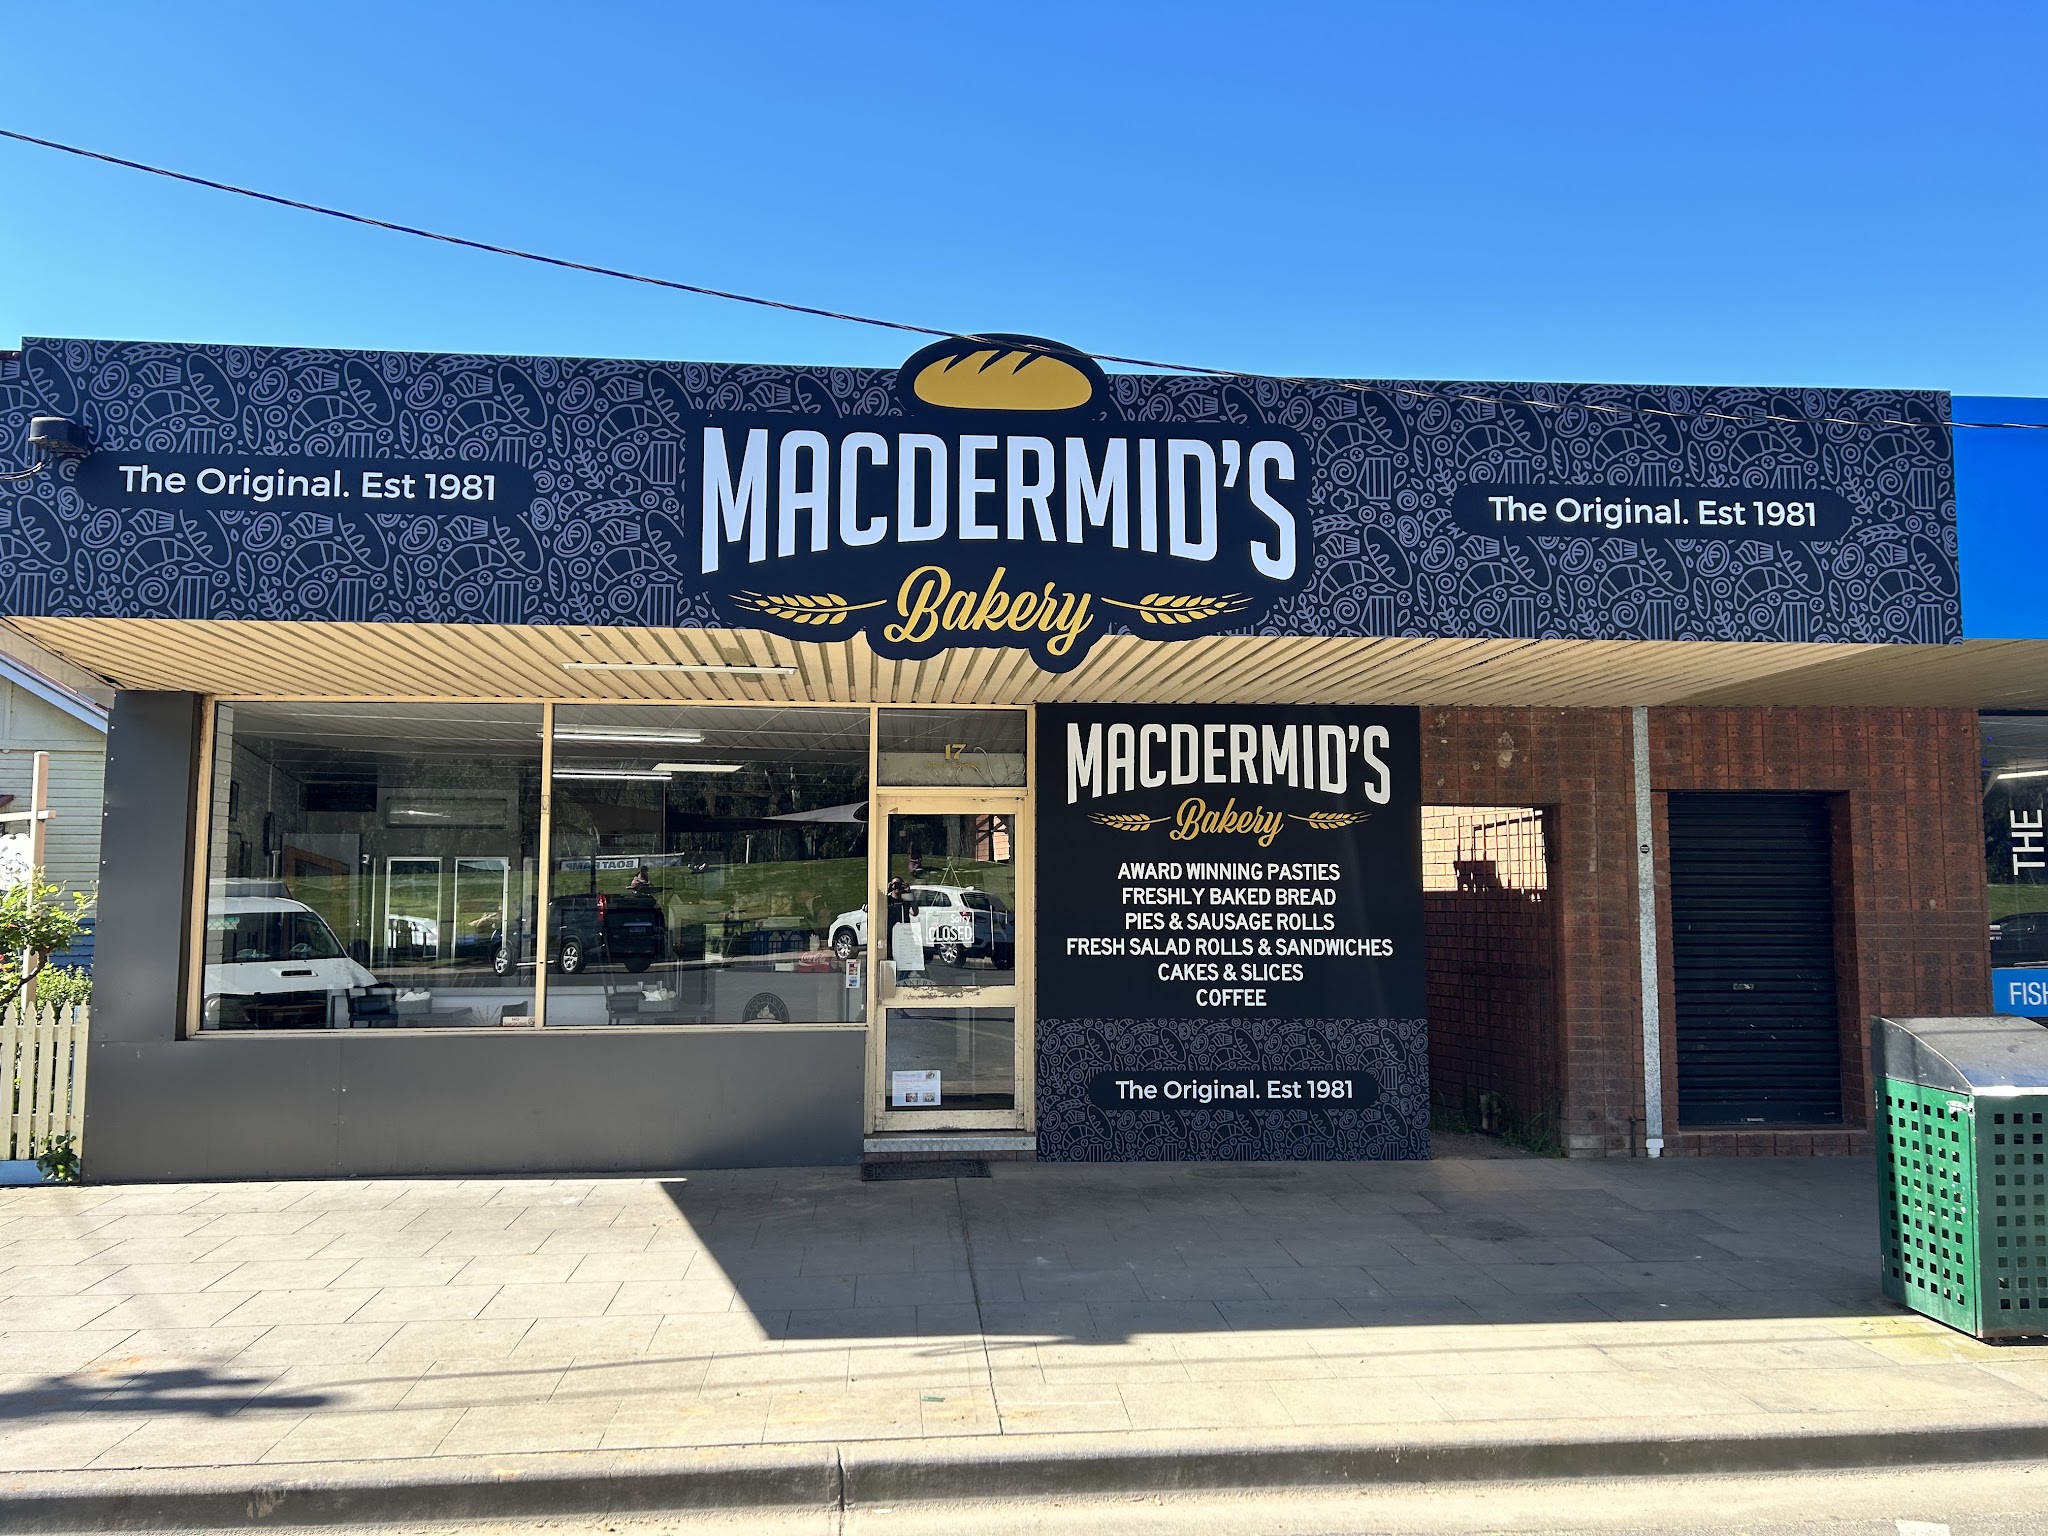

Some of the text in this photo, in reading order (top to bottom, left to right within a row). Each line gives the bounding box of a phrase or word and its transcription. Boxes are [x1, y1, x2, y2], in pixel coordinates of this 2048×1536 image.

[118, 464, 495, 502] The Original. Est 1981
[702, 427, 1296, 582] MACDERMID'S
[1489, 495, 1816, 530] The Original. Est 1981
[884, 565, 1095, 657] Bakery
[945, 743, 967, 760] 17
[1067, 722, 1391, 805] MACDERMID'S
[1169, 797, 1283, 847] Bakery
[2010, 809, 2046, 876] THE
[1117, 862, 1341, 881] AWARD WINNING PASTIES
[1122, 887, 1337, 906] FRESHLY BAKED BREAD
[950, 914, 971, 925] Sorry
[1125, 912, 1336, 931] PIES & SAUSAGE ROLLS
[928, 925, 973, 942] CLOSED
[1066, 937, 1394, 957] FRESH SALAD ROLLS & SANDWICHES
[1157, 963, 1304, 982] CAKES & SLICES
[1195, 988, 1267, 1007] COFFEE
[1115, 1079, 1353, 1104] The Original. Est 1981
